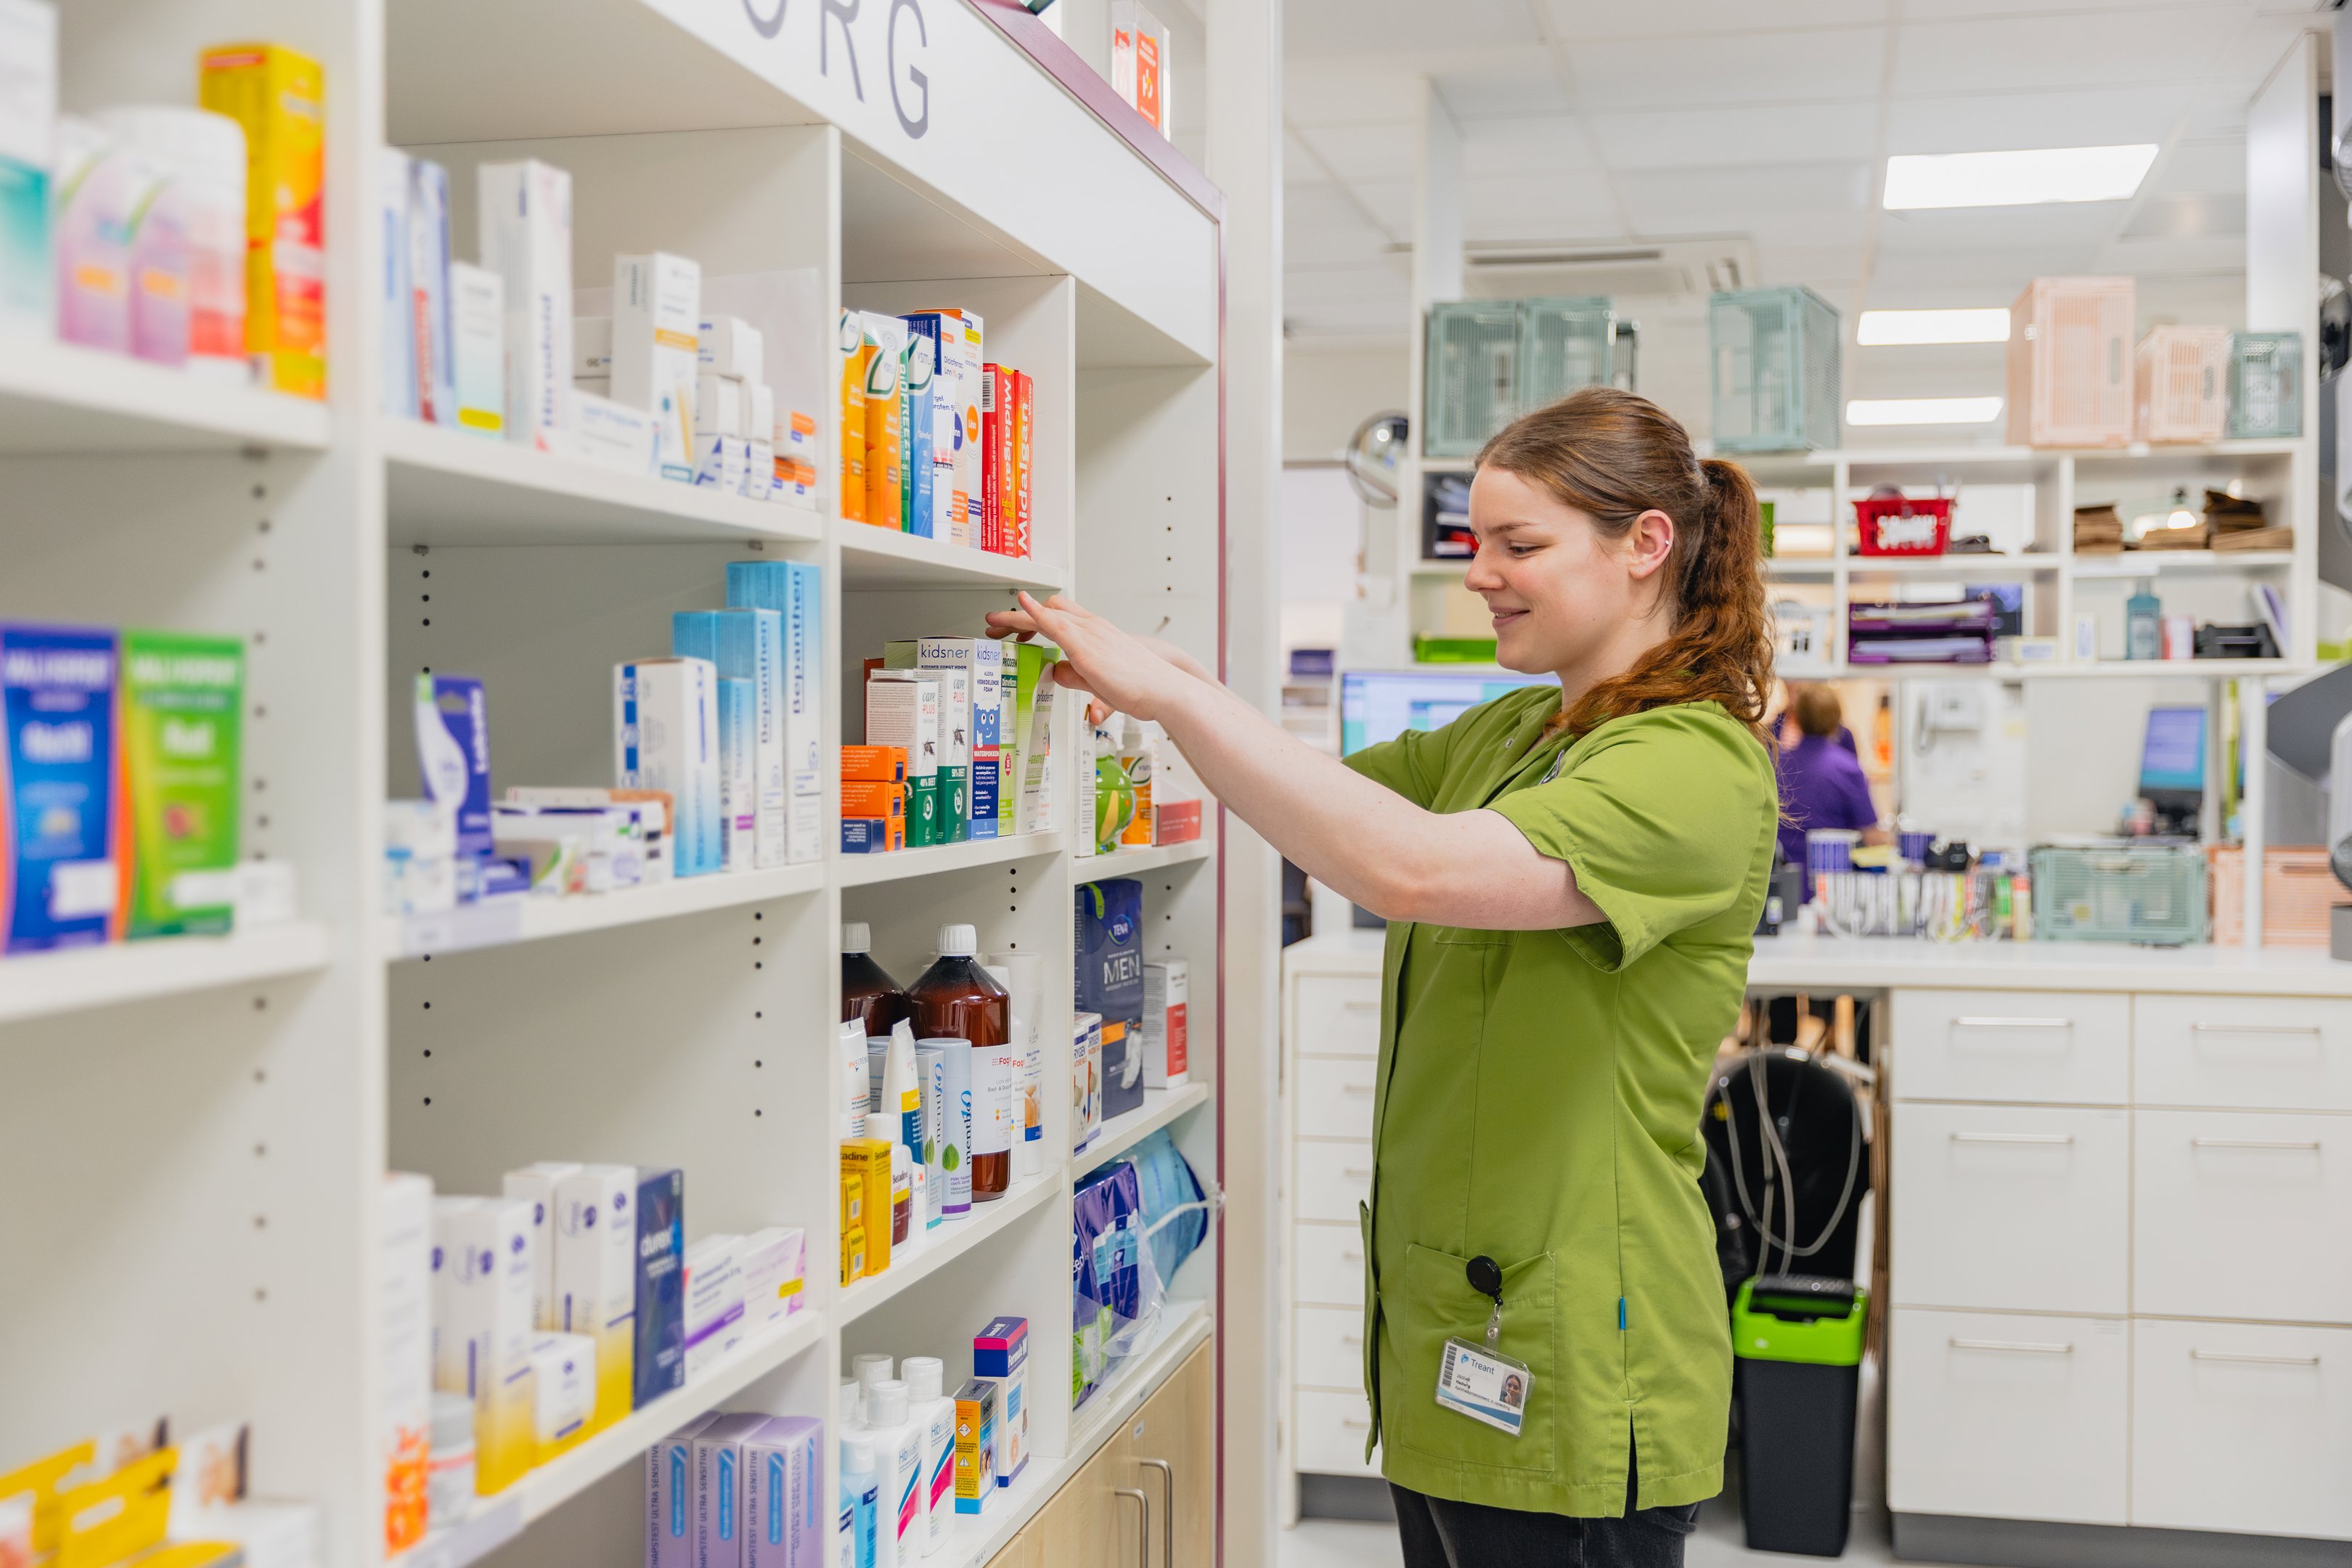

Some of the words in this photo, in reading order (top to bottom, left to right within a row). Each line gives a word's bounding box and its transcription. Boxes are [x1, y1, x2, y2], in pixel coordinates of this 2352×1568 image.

[917, 352, 928, 364] vsm
[944, 356, 963, 369] Diclofenac
[899, 364, 910, 460] BIOFREEZE
[1004, 378, 1013, 491] Midalgan
[1018, 403, 1029, 552] Midalgan
[792, 571, 804, 714] Bepanthen
[921, 644, 970, 658] kidsner
[976, 644, 1000, 661] kidsner
[760, 620, 770, 743] Bepanthen
[953, 678, 965, 690] care
[922, 691, 935, 702] care
[953, 692, 965, 703] PLUS
[922, 703, 935, 714] PLUS
[1113, 922, 1128, 936] TENA
[1103, 954, 1140, 984] MEN
[850, 1234, 864, 1247] Betadine
[1008, 1343, 1023, 1369] Formule
[1022, 1335, 1028, 1356] W
[1471, 1358, 1495, 1375] Treant
